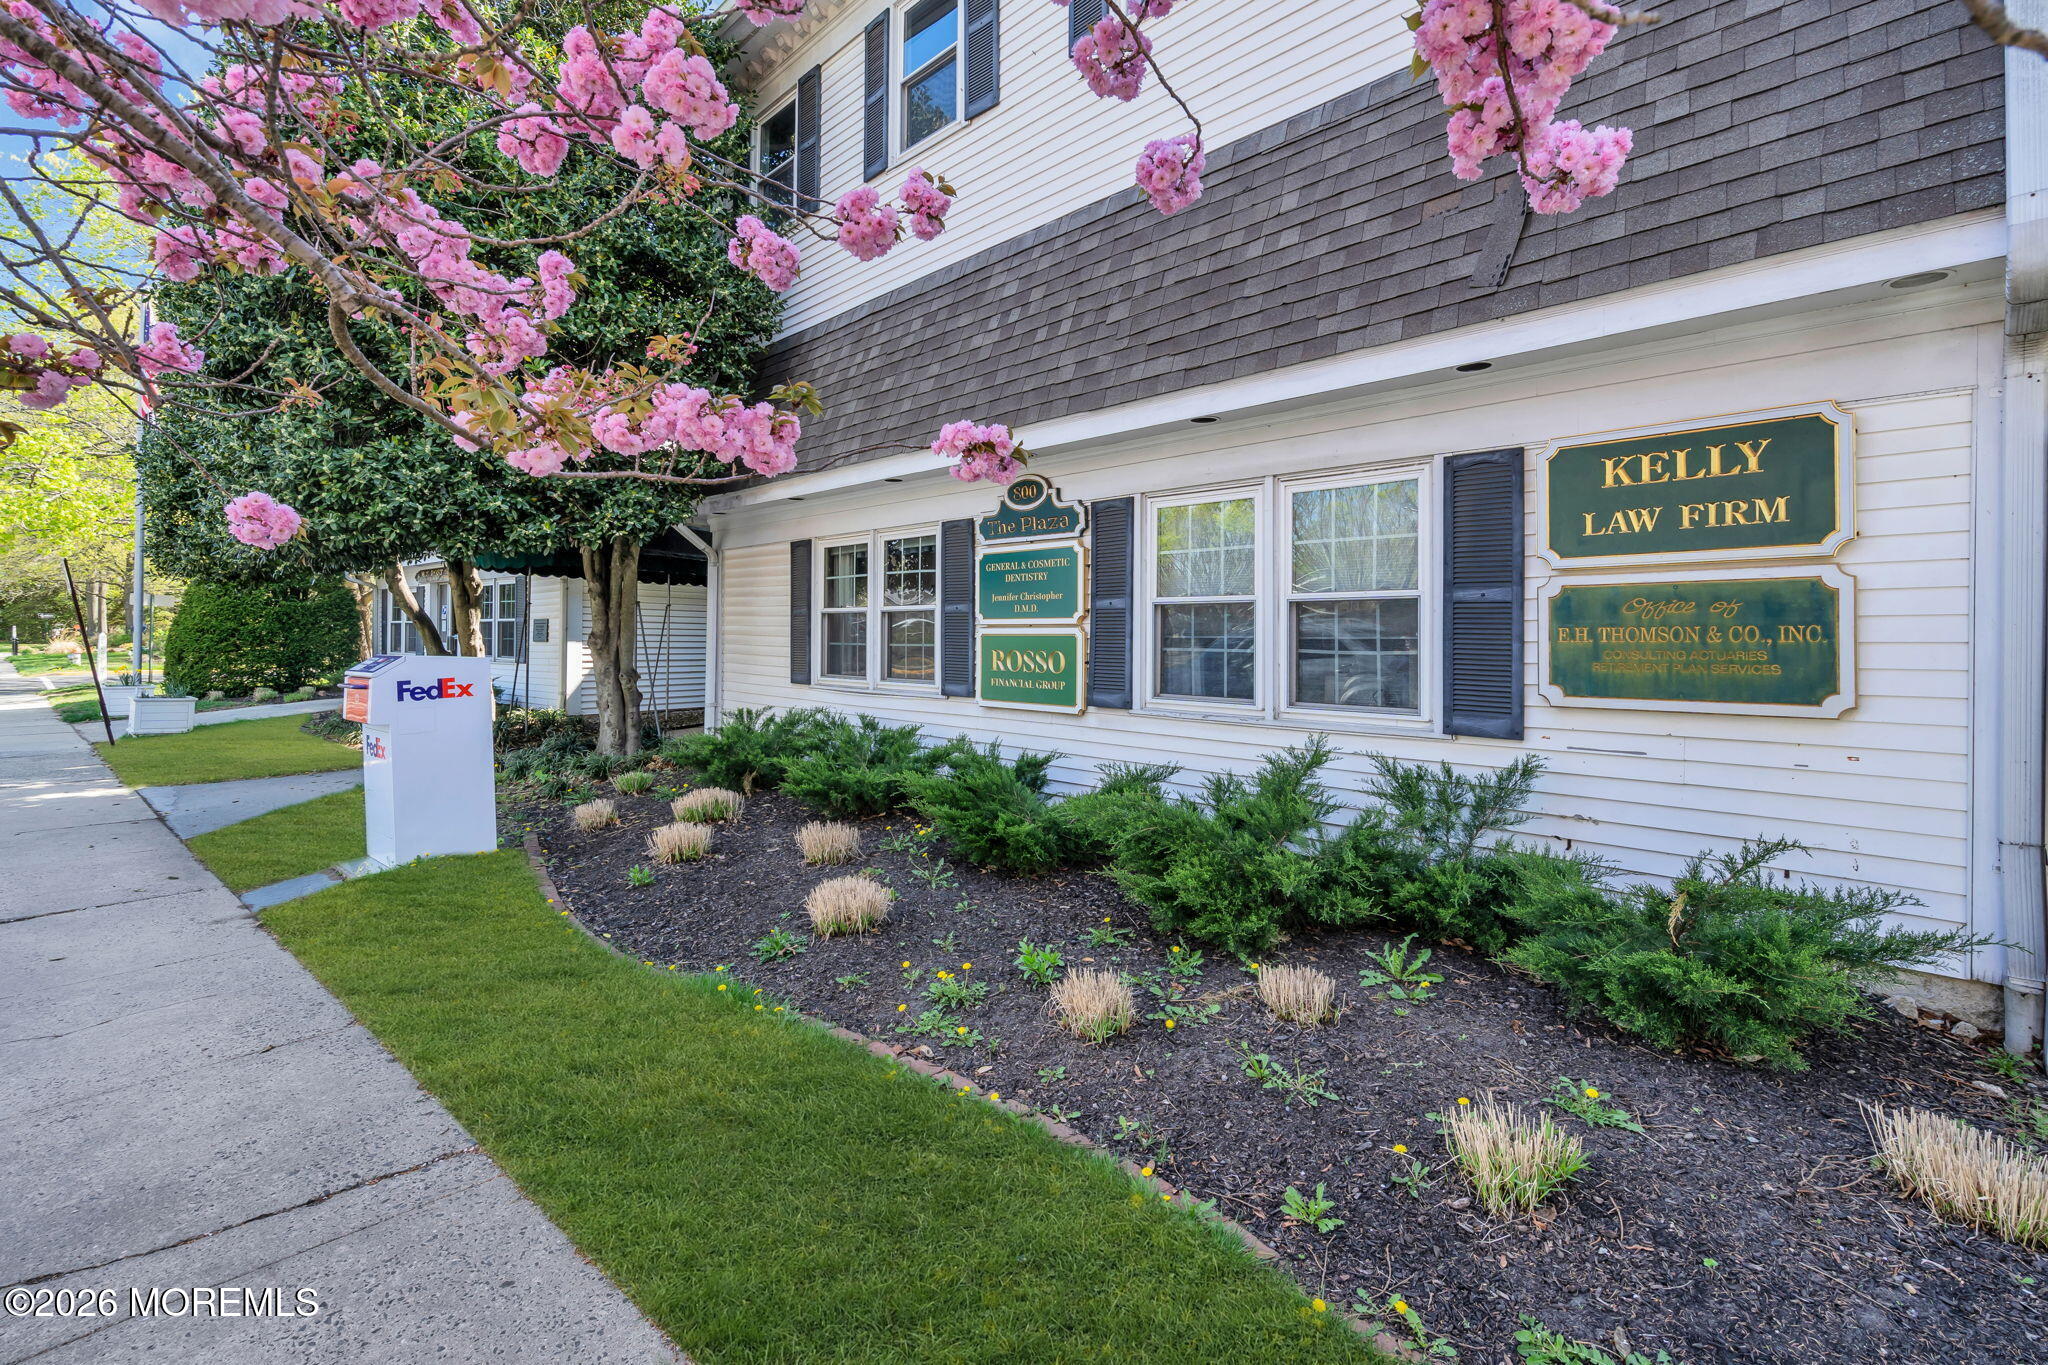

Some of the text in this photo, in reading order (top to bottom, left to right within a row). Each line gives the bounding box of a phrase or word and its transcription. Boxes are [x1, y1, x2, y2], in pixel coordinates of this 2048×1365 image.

[1601, 438, 1772, 488] KELLY
[1013, 484, 1037, 501] 800
[1582, 495, 1790, 536] LAW FIRM
[987, 515, 1069, 536] The Plaza
[985, 558, 1070, 572] GENERAL & COSMETIC
[1005, 572, 1048, 583] DENTISTRY
[992, 591, 1063, 603] Jennifer Christopher
[1014, 604, 1039, 613] D.M.D.
[1623, 597, 1743, 619] Office of
[1557, 624, 1829, 647] E.H. THOMSON & CO., INC.
[991, 649, 1066, 674] ROSSO
[1603, 650, 1768, 661] CONSULTING ACTUARIES
[1592, 662, 1782, 676] RETIREMENT PLAN SERVICES
[396, 677, 474, 702] FedEx
[991, 678, 1066, 691] FINANCIAL GROUP
[366, 734, 386, 760] FedEx
